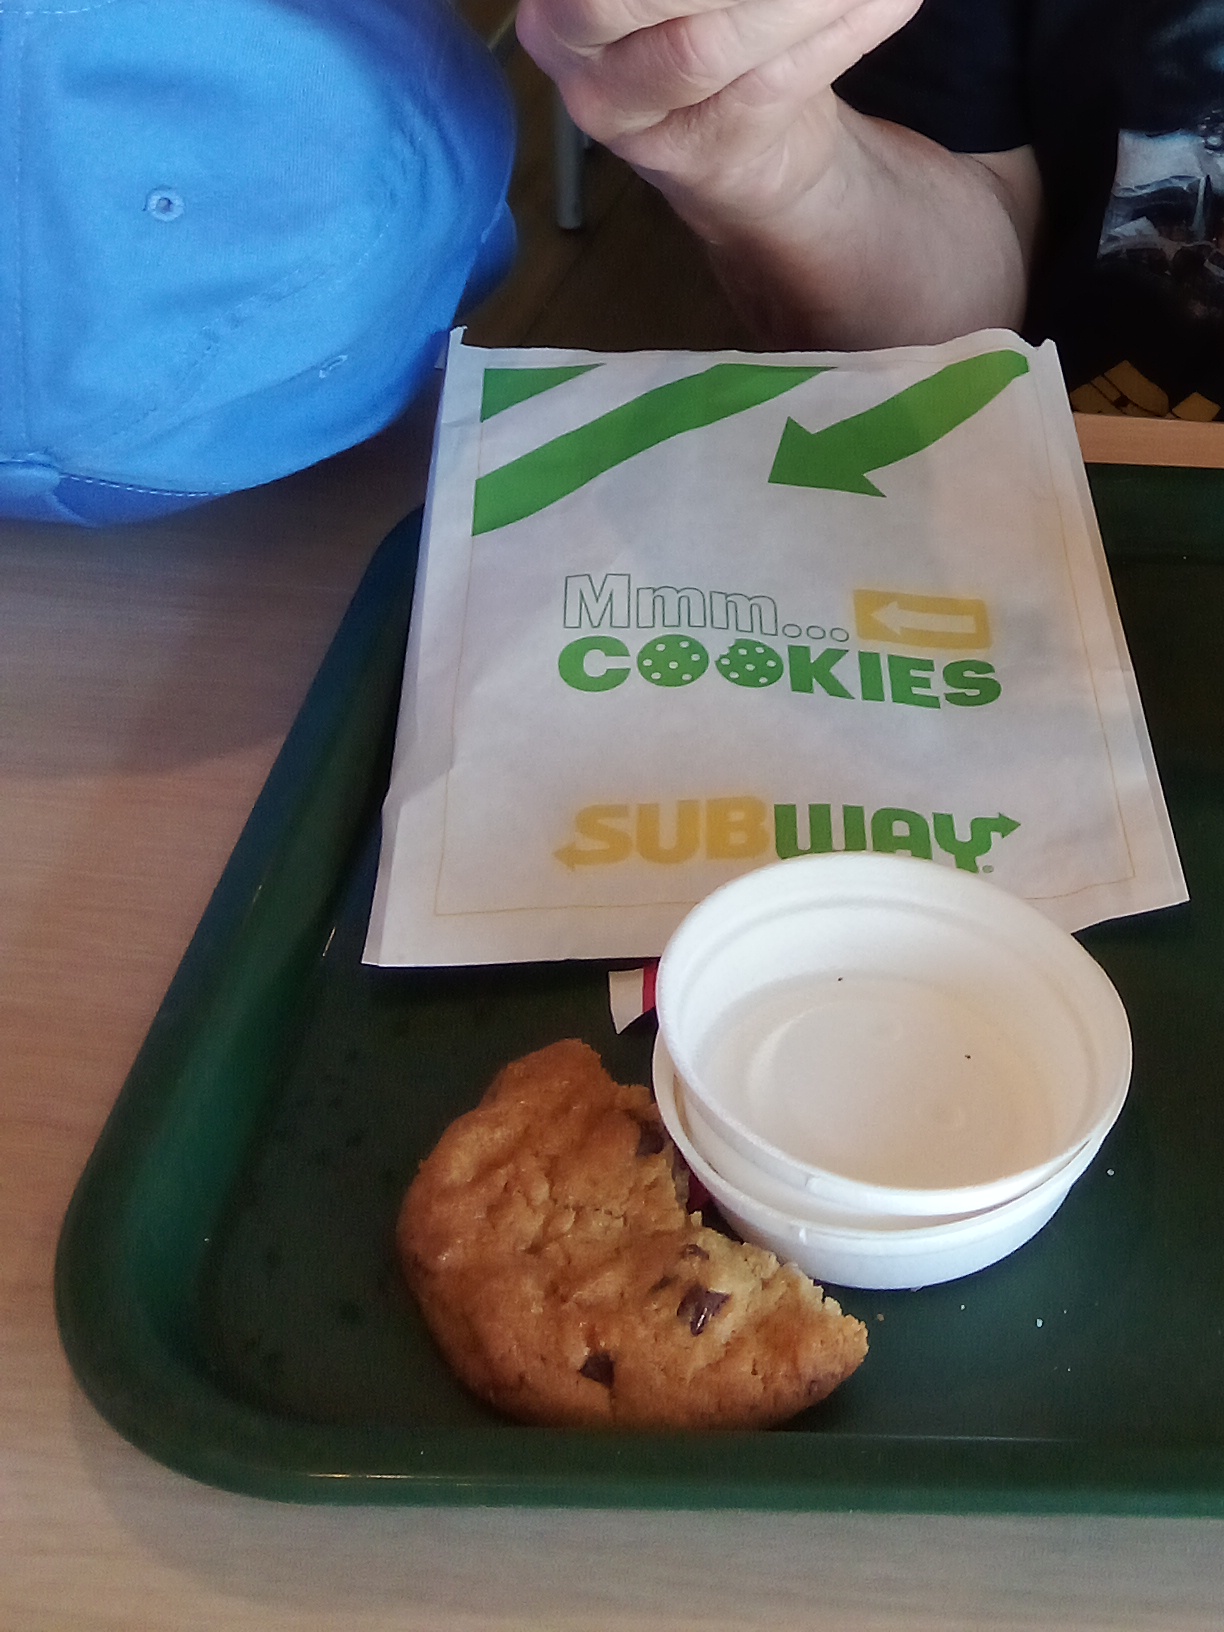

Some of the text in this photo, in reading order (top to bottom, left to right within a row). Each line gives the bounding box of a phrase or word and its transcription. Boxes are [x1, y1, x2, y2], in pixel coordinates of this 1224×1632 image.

[563, 573, 851, 643] Mmm...
[557, 633, 1003, 710] COOKIES
[552, 795, 1022, 875] SUBWAY
